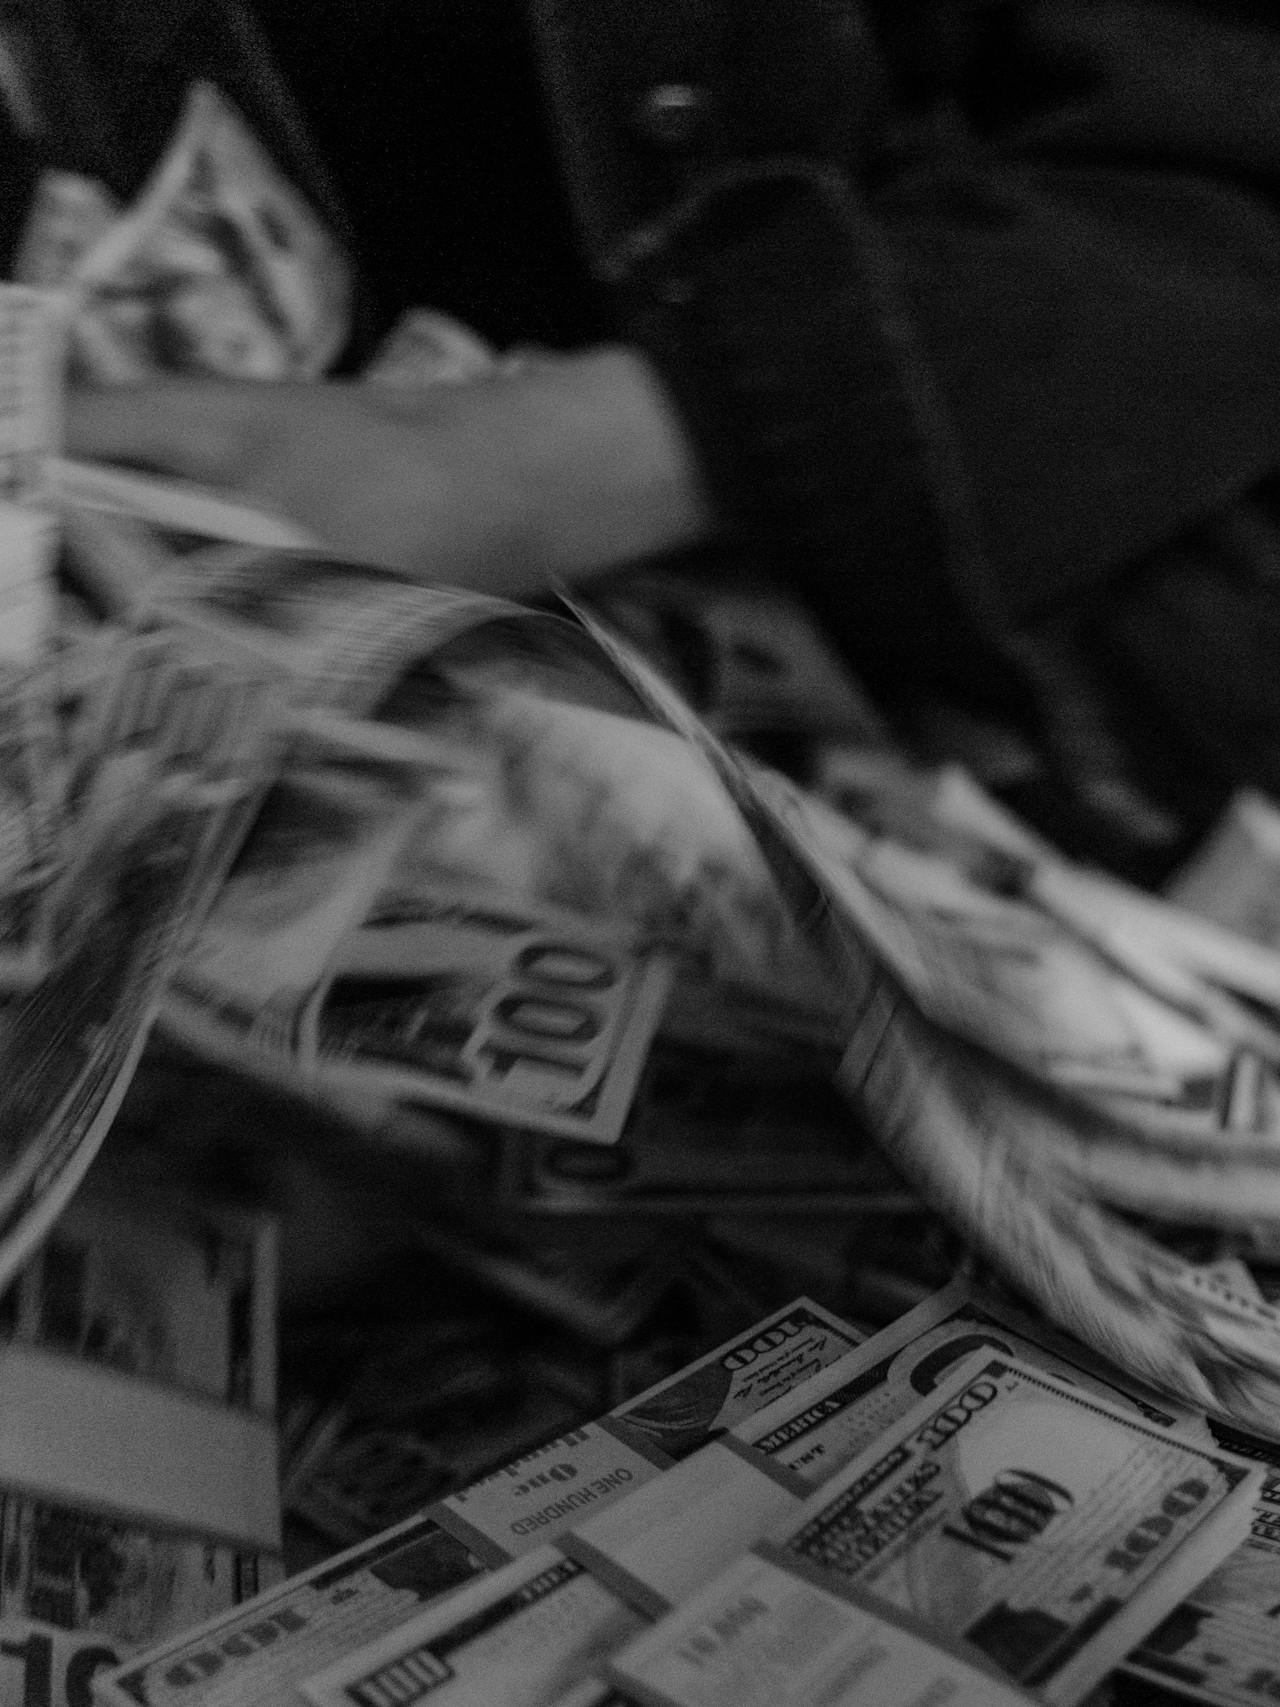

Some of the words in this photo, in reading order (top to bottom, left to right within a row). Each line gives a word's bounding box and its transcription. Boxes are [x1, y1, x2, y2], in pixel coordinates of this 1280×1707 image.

[757, 1398, 841, 1456] MERICA
[916, 1380, 1001, 1452] 100
[590, 1462, 634, 1498] ONE
[507, 1481, 595, 1542] HUNDRED
